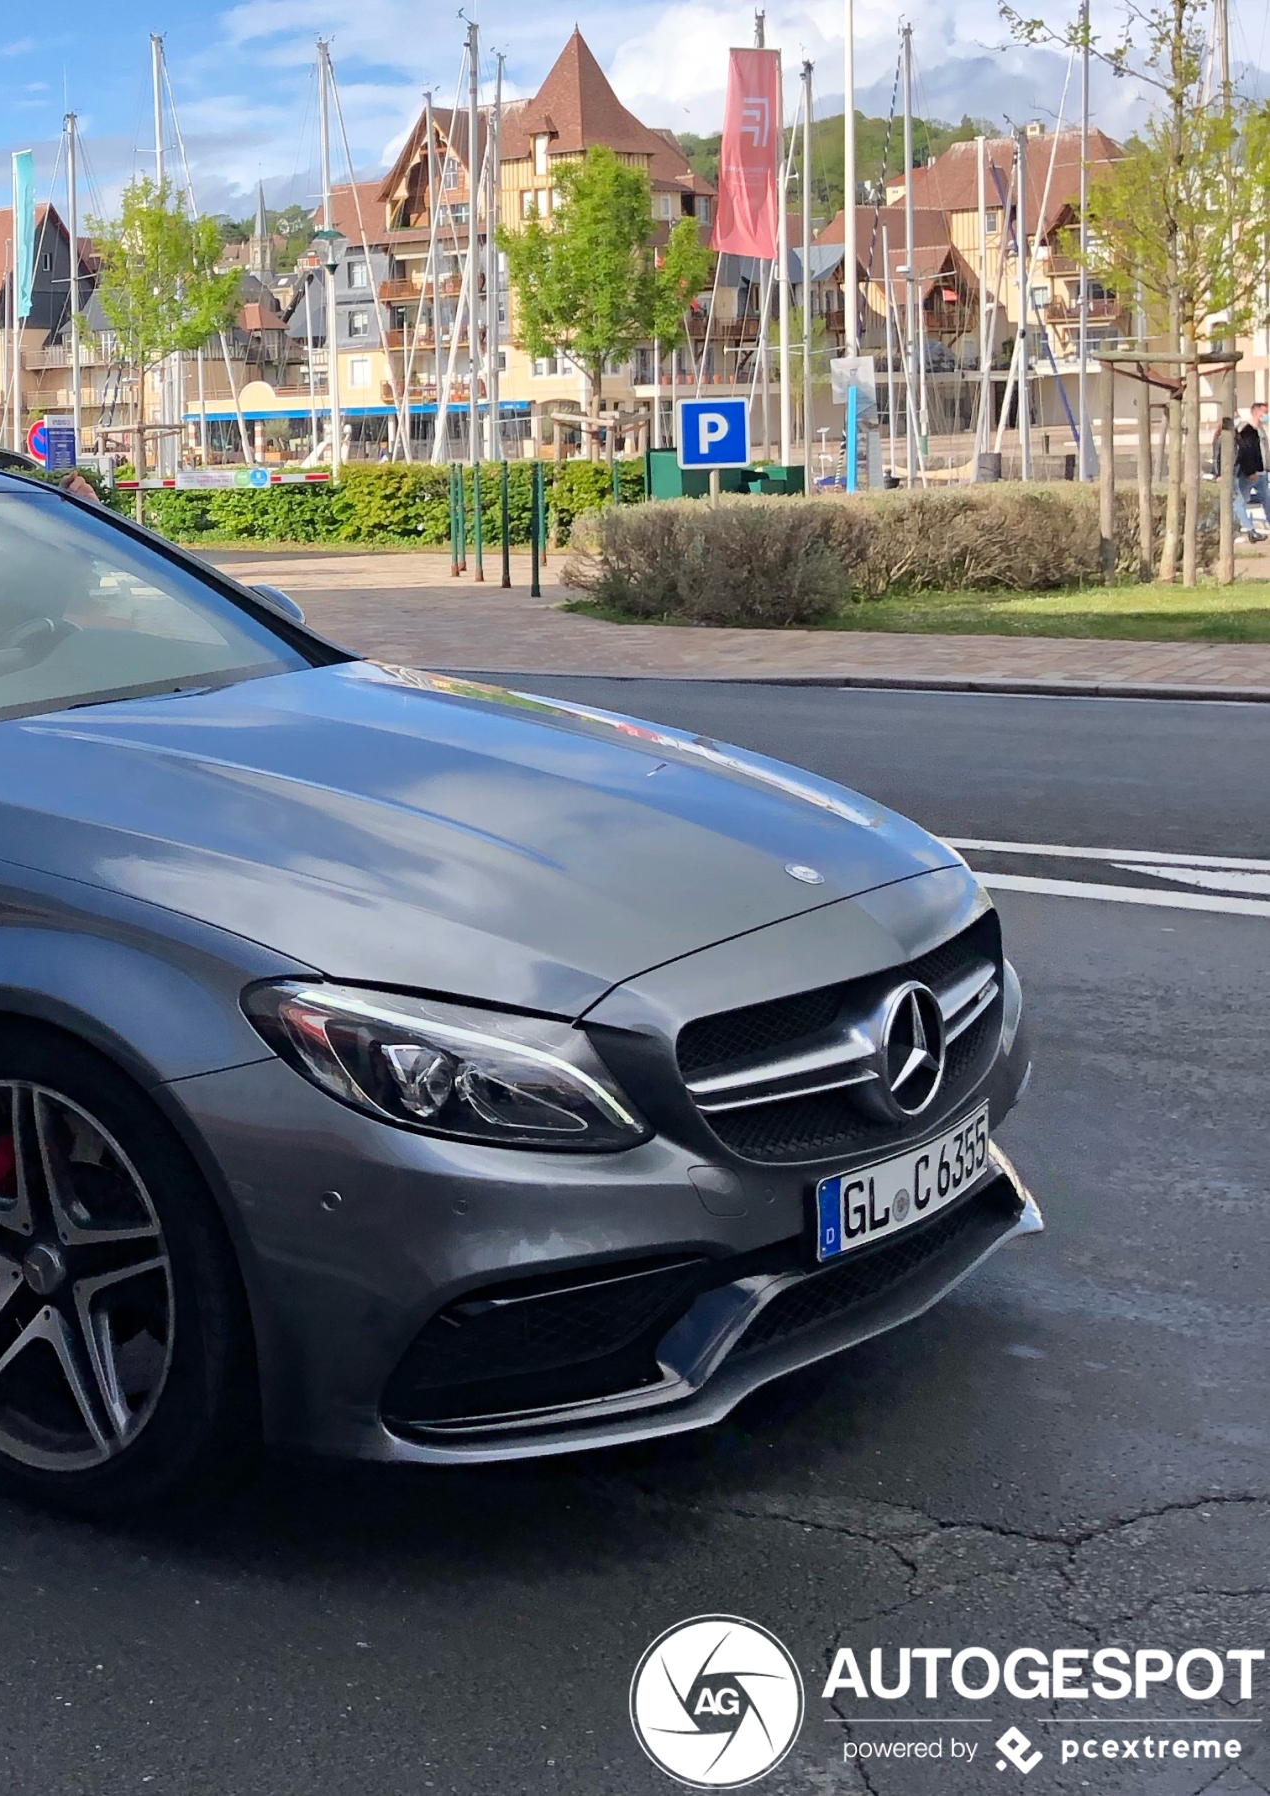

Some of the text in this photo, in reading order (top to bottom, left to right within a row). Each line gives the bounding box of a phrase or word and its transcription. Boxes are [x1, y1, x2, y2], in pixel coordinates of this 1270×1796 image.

[698, 412, 729, 455] P
[843, 1114, 986, 1239] GL C 6355
[826, 1227, 835, 1245] D
